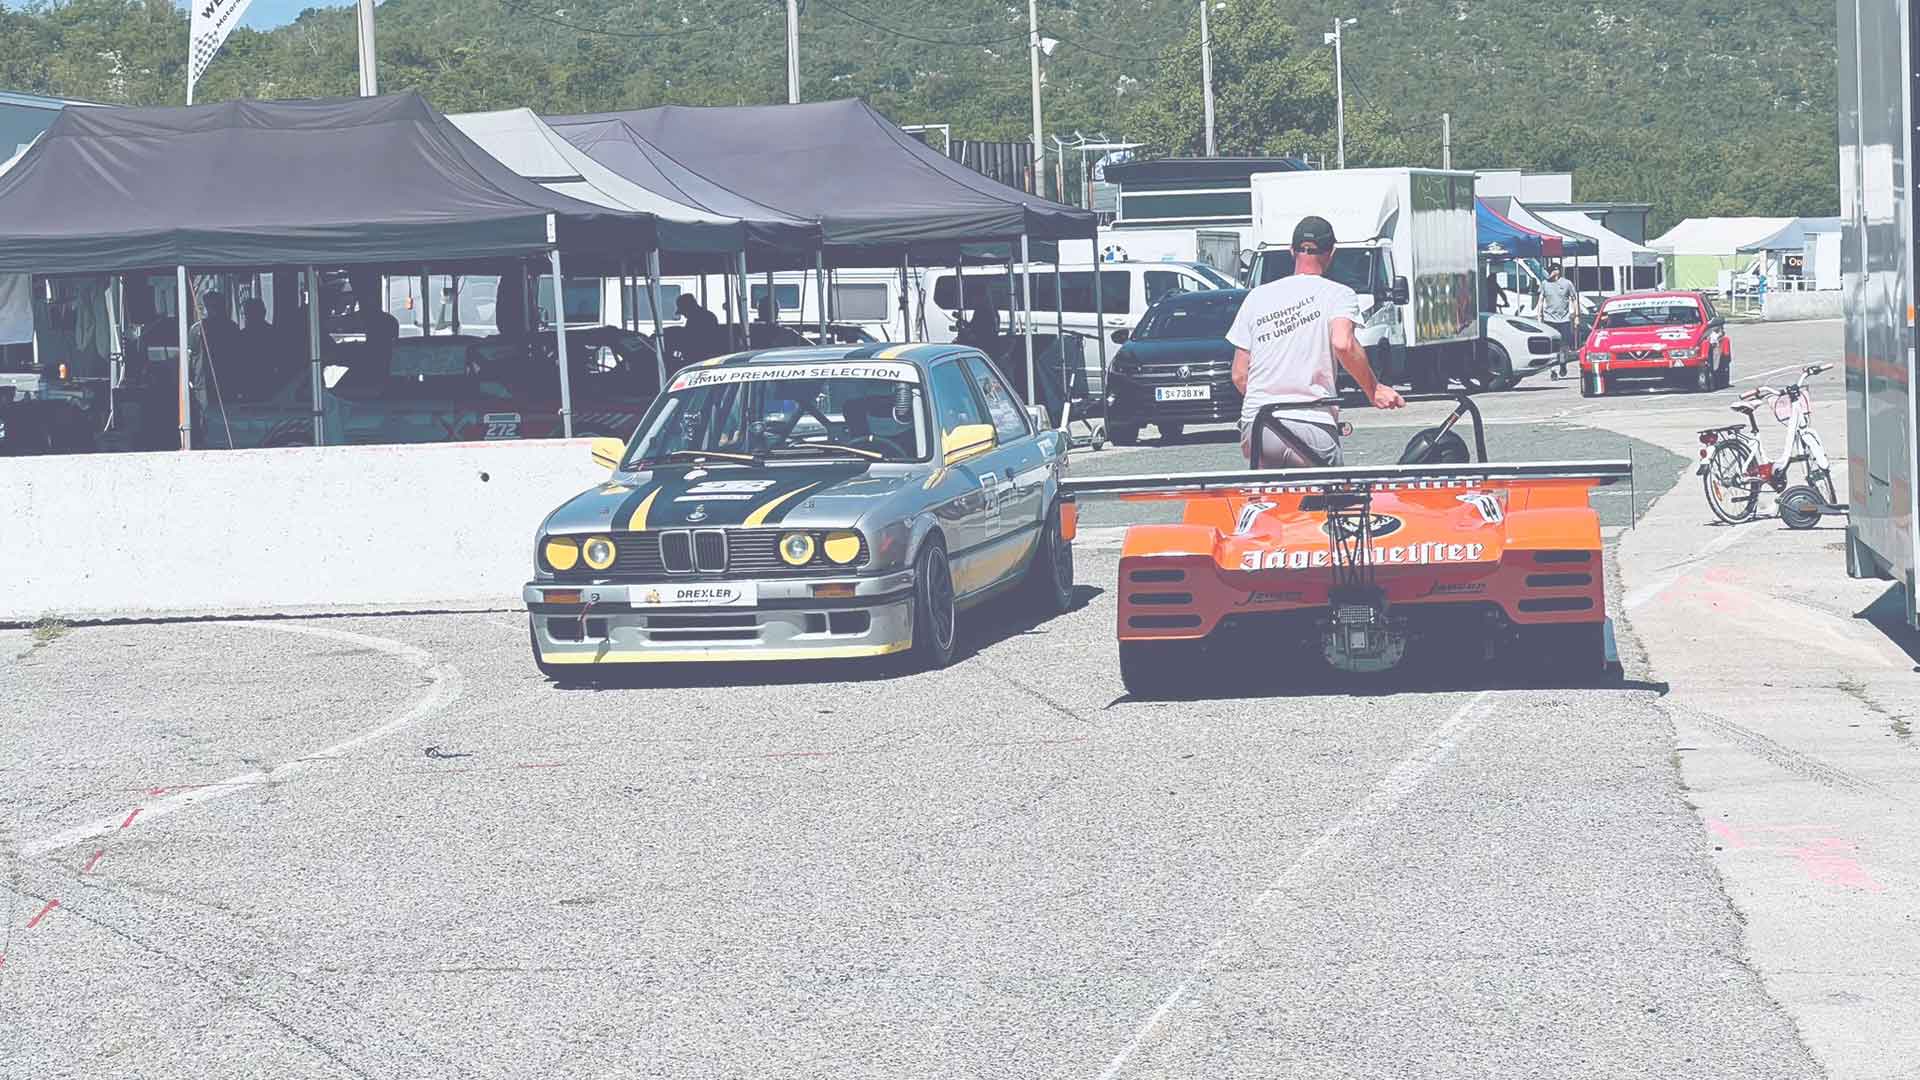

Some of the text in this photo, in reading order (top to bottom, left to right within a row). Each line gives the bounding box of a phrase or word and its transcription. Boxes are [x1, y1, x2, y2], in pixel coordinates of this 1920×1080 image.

[1257, 332, 1271, 342] YET
[687, 372, 728, 386] BMW
[730, 369, 806, 381] PREMIUM
[809, 367, 901, 379] SELECTION
[676, 588, 732, 599] DREXLER
